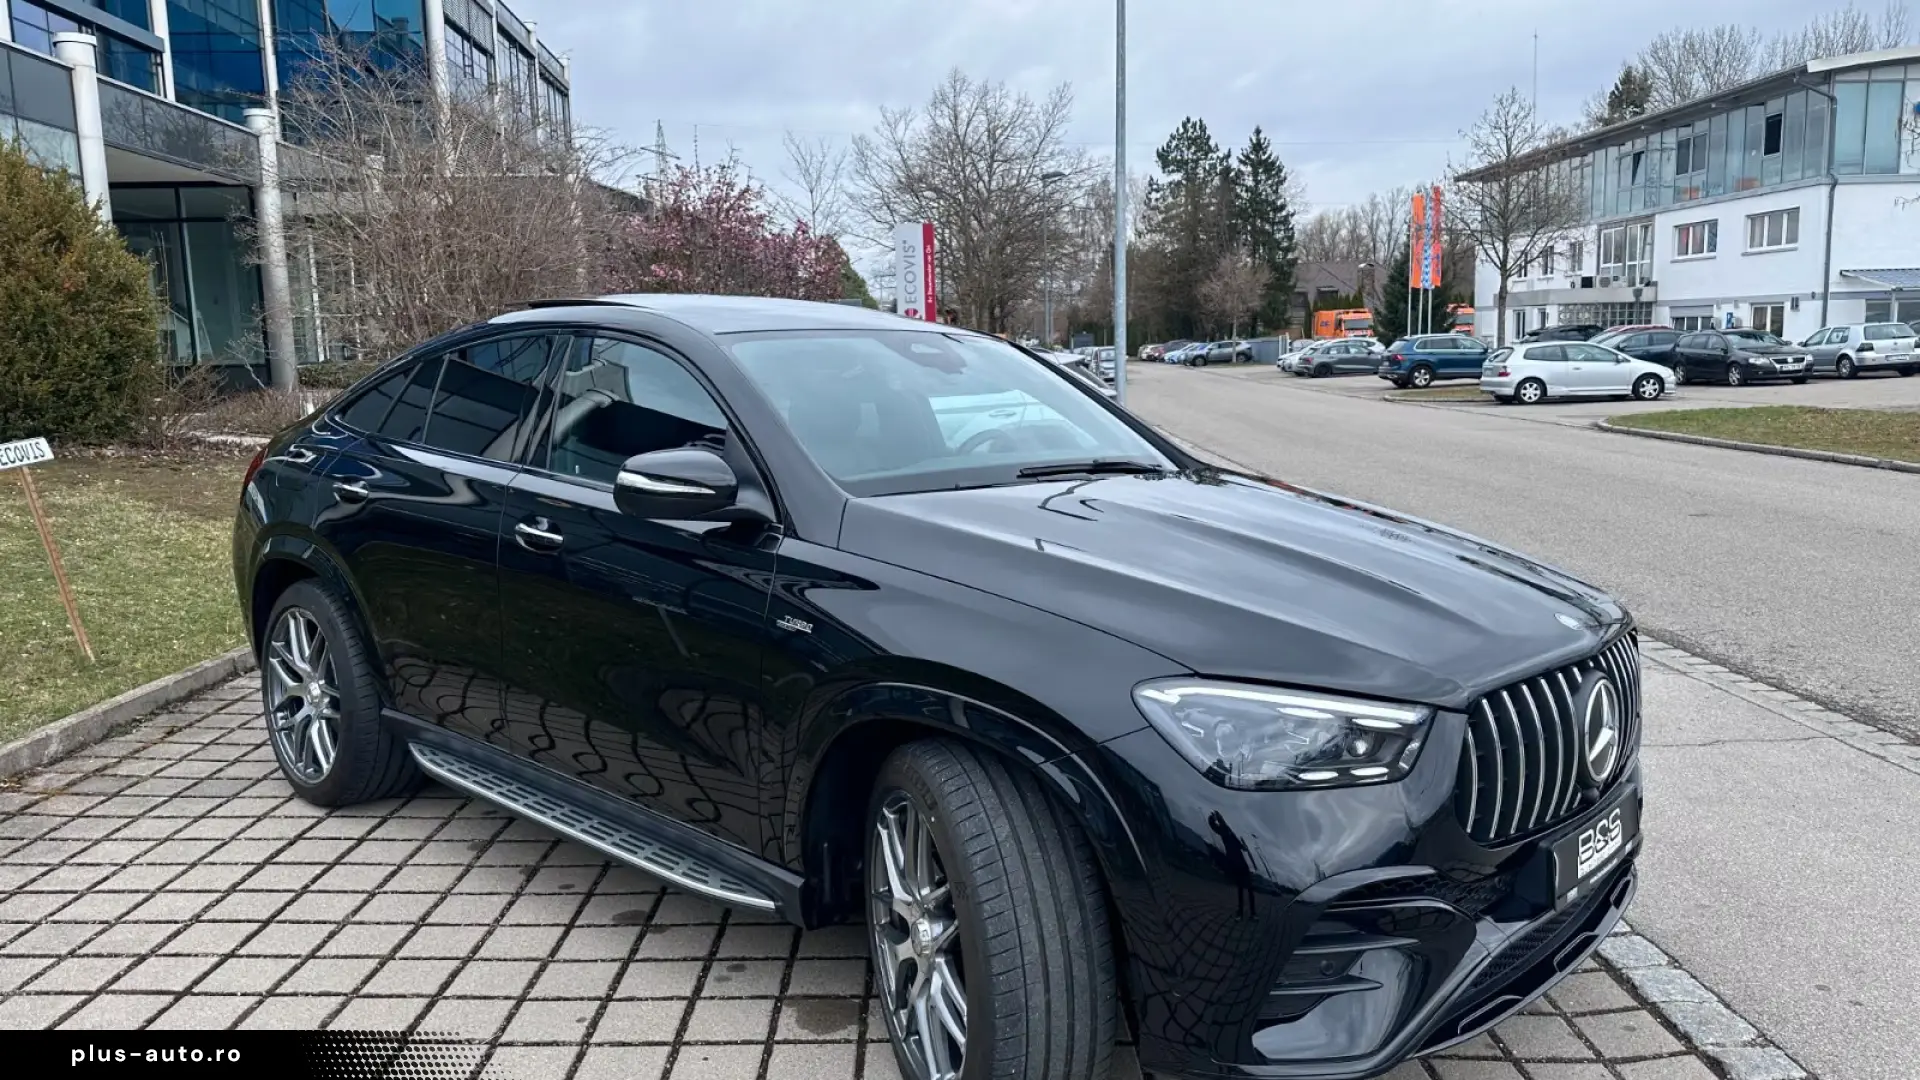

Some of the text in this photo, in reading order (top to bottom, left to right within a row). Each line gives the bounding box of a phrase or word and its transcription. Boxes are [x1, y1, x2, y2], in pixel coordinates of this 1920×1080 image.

[902, 244, 918, 305] ECOVIS
[784, 615, 814, 631] TURBO
[1578, 807, 1622, 865] B&S
